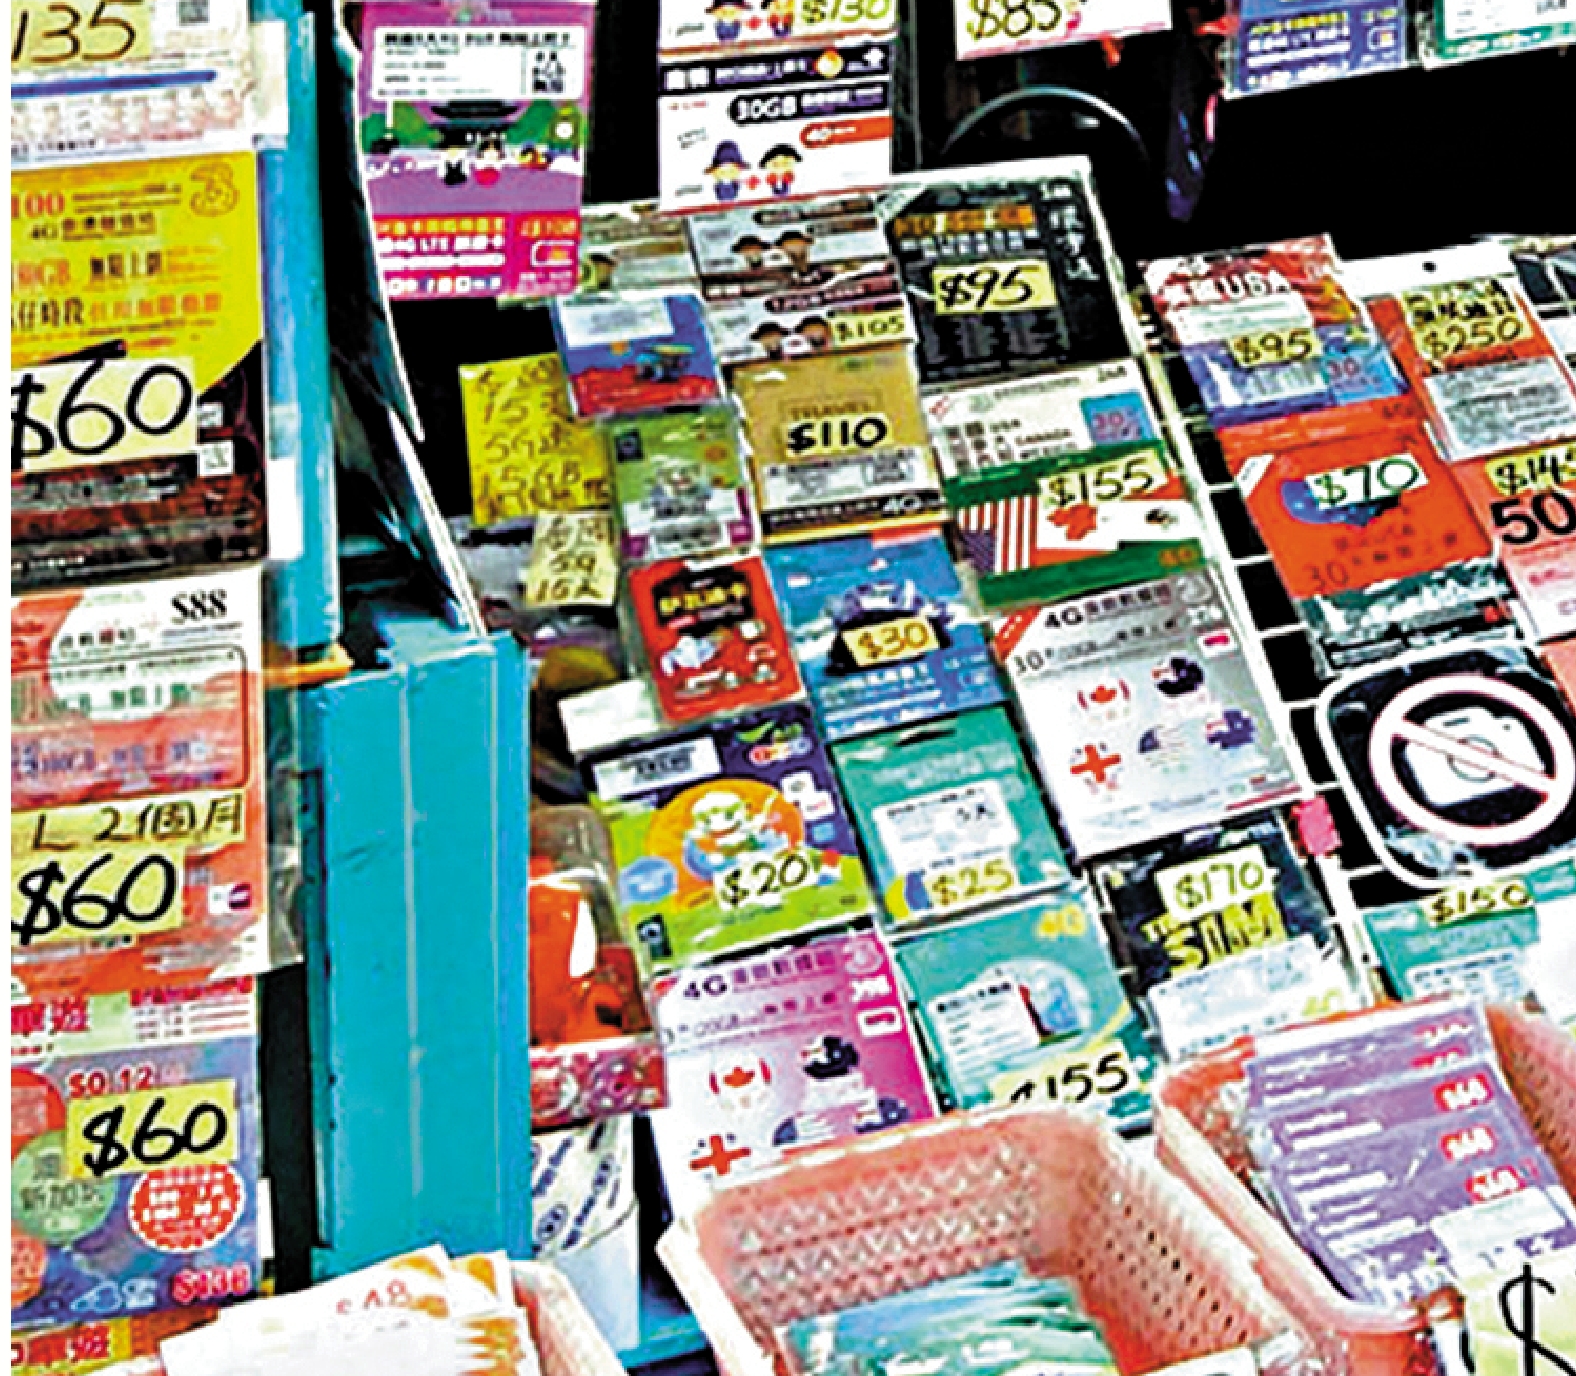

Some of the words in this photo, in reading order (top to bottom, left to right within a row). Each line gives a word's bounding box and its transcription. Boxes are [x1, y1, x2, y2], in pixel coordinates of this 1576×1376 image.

[737, 94, 798, 120] 30GB
[937, 266, 1033, 311] $95
[1235, 330, 1311, 363] $95
[1423, 317, 1523, 363] $250
[11, 358, 194, 468] $60
[787, 417, 887, 451] $110
[1040, 461, 1155, 507] $155
[1320, 458, 1419, 504] $70
[1044, 606, 1083, 628] 4G
[857, 624, 930, 660] $30
[12, 853, 177, 945] $60
[720, 855, 807, 906] $20
[931, 863, 1014, 905] $25
[1174, 861, 1265, 909] $170
[1430, 884, 1532, 925] $150
[1163, 893, 1285, 973] SIM
[683, 973, 728, 1002] 4G
[82, 1097, 227, 1177] $60
